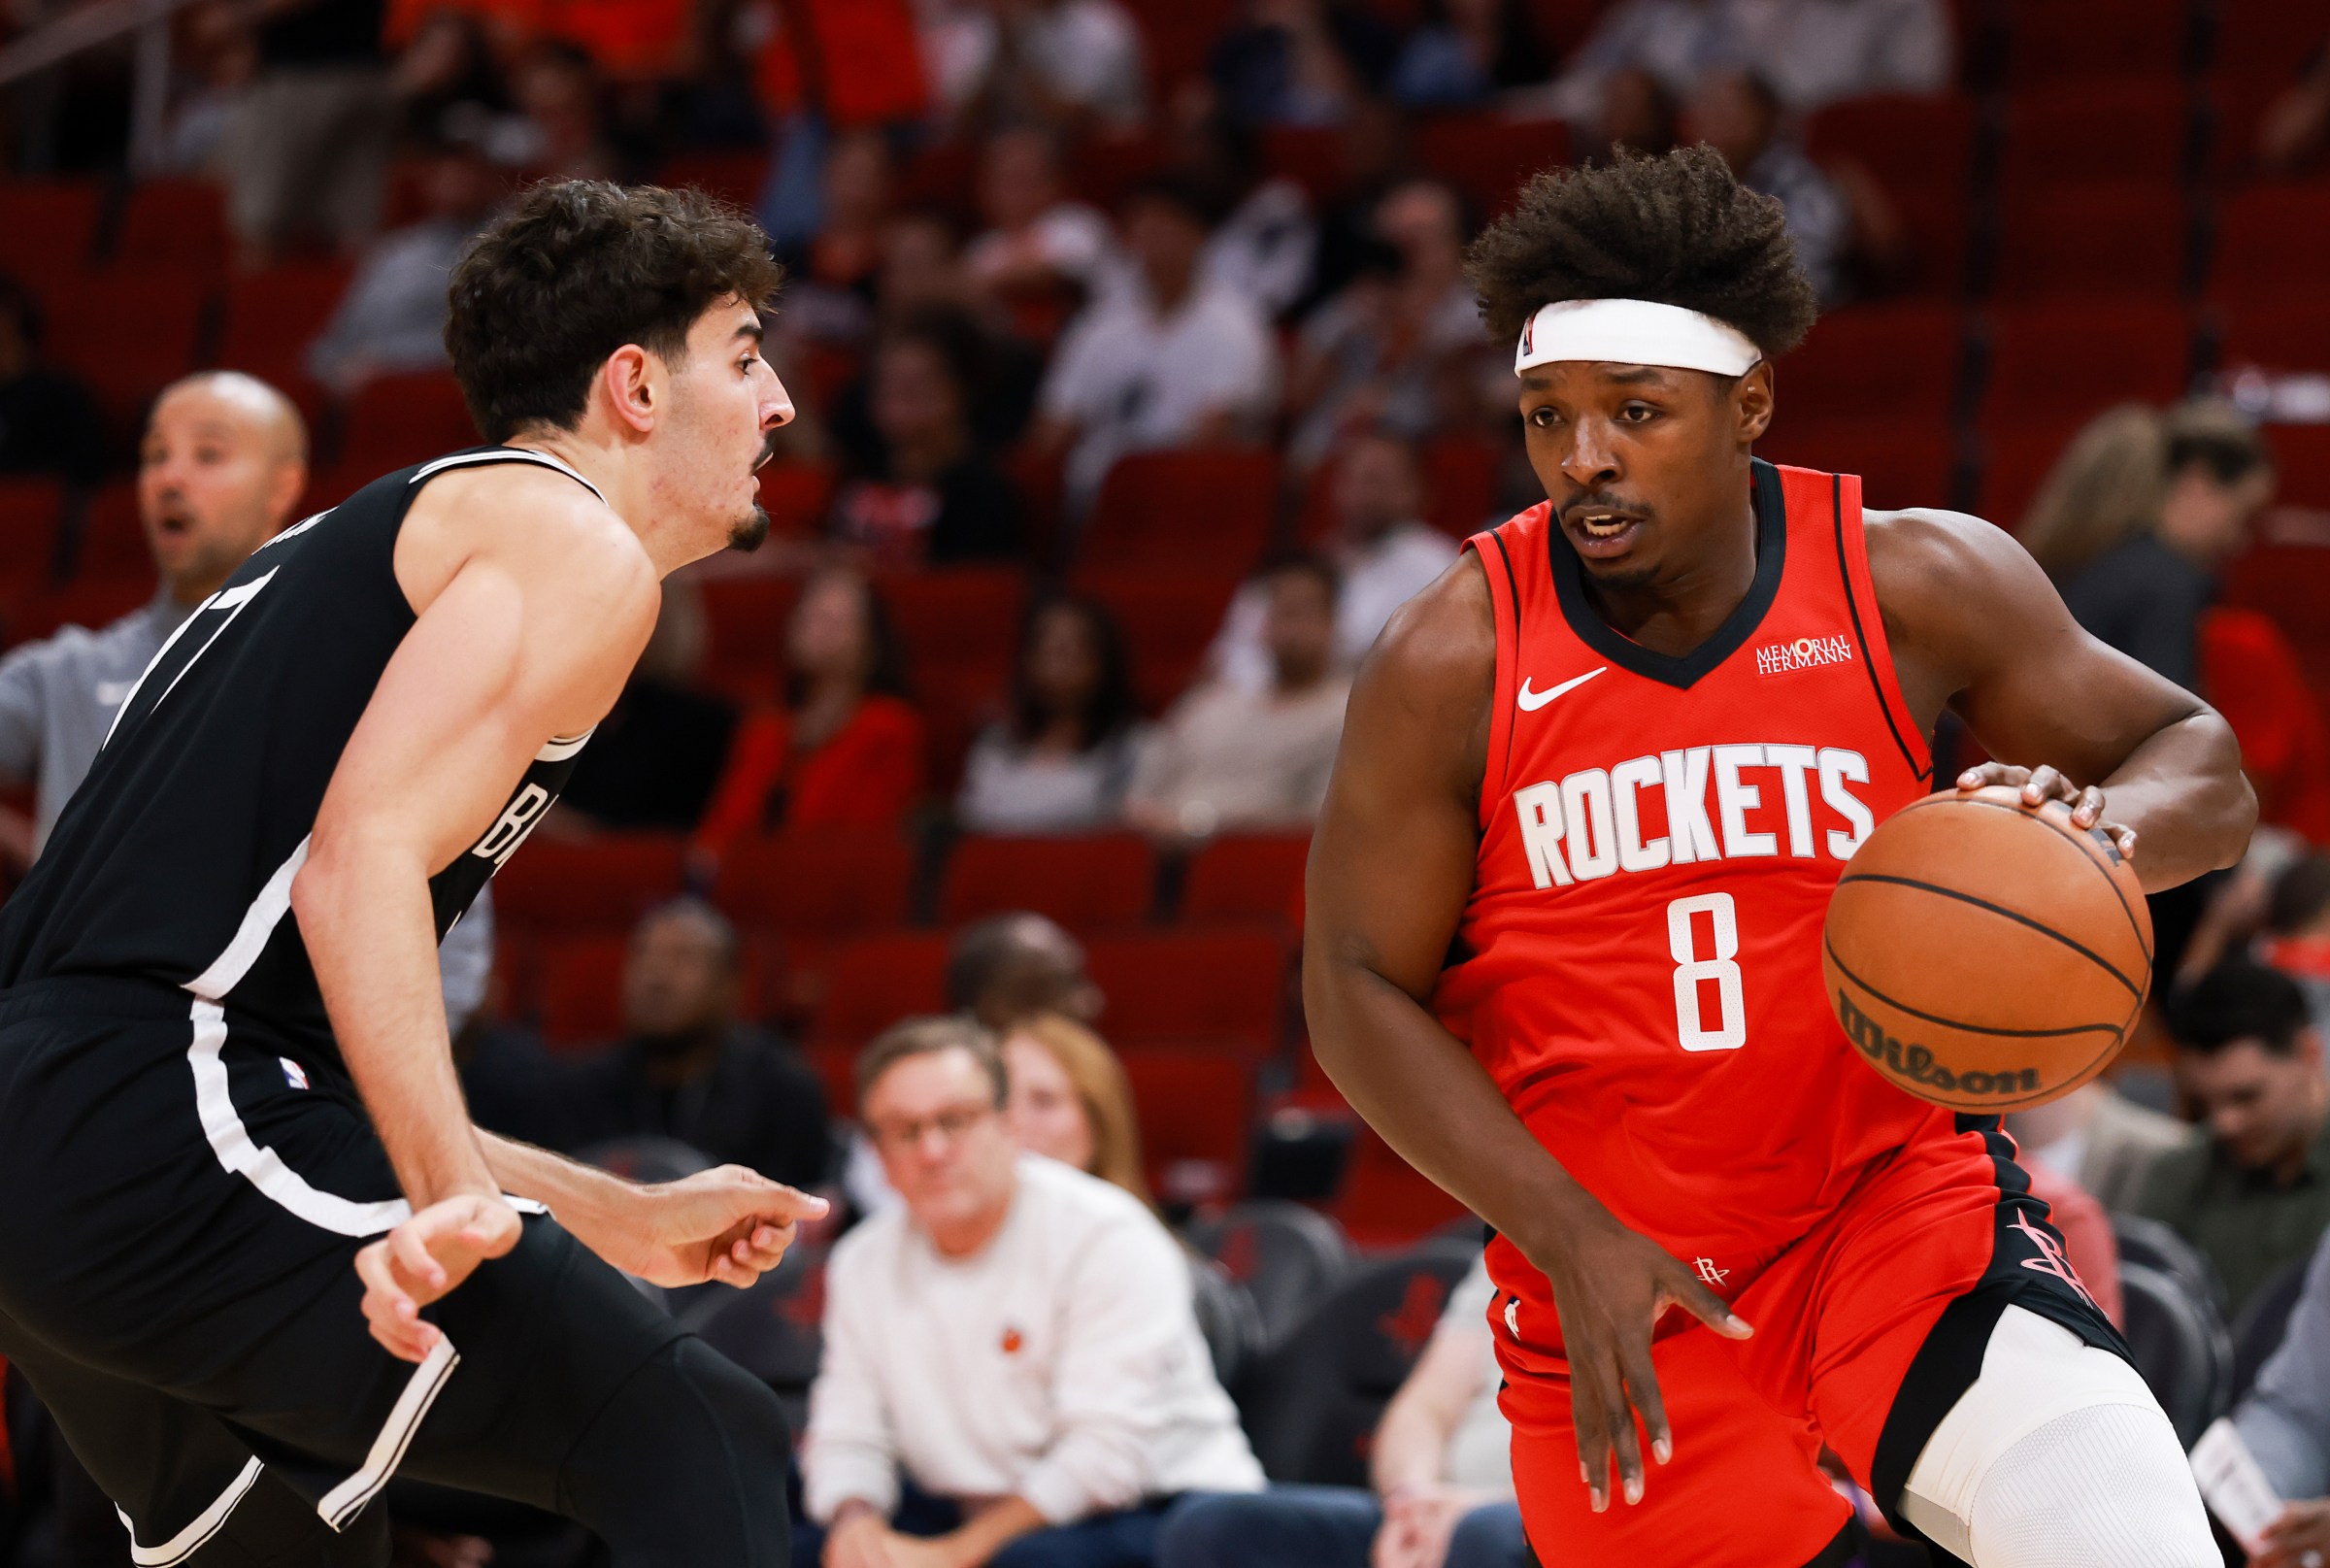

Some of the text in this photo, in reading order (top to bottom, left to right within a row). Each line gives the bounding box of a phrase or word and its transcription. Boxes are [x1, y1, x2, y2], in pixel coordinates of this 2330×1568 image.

[1756, 634, 1850, 663] MEMORIAL
[1758, 647, 1852, 675] HERMANN
[1513, 743, 1875, 890] ROCKETS
[1667, 892, 1747, 1051] 8
[1839, 986, 2041, 1094] Wilson
